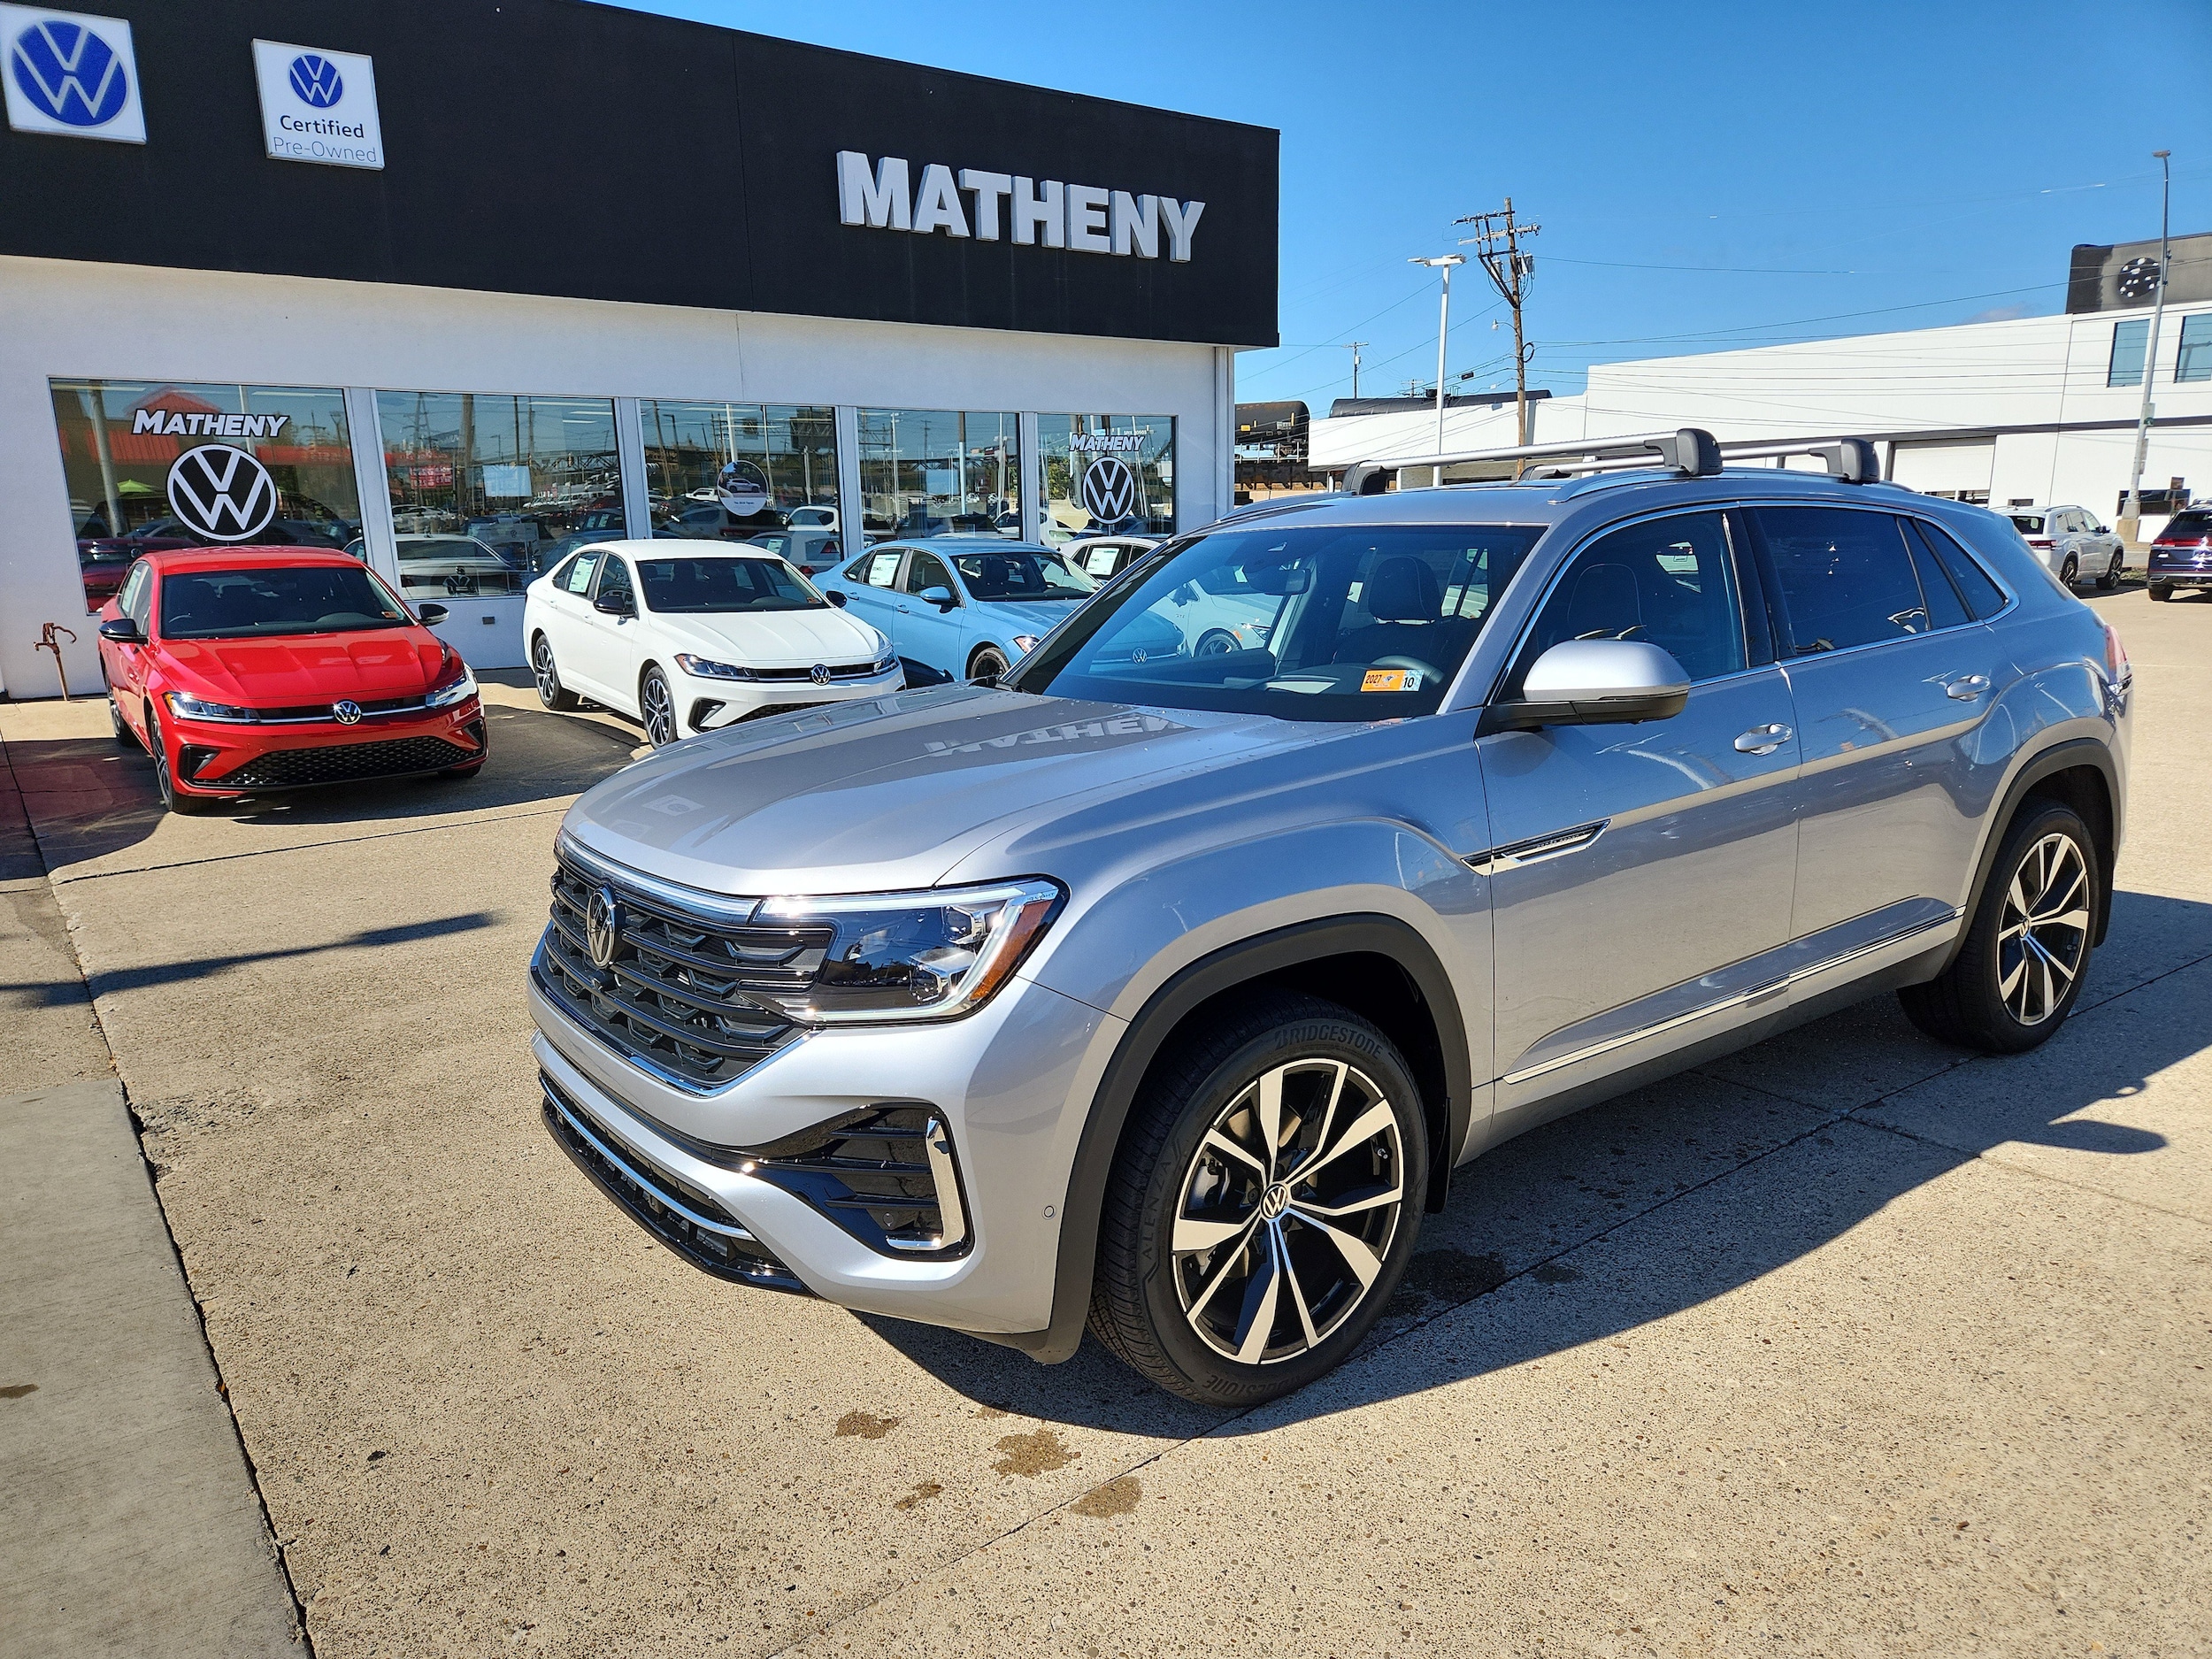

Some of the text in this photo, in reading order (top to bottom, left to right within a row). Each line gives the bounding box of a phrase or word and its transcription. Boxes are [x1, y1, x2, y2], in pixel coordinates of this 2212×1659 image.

[280, 115, 365, 139] Certified
[273, 136, 377, 162] Pre-Owned
[836, 150, 1206, 263] MATHENY
[133, 409, 290, 438] MATHENY
[1069, 434, 1145, 451] MATHENY
[1365, 674, 1415, 688] 2027 10
[1274, 1024, 1384, 1060] BRIDGESTONE
